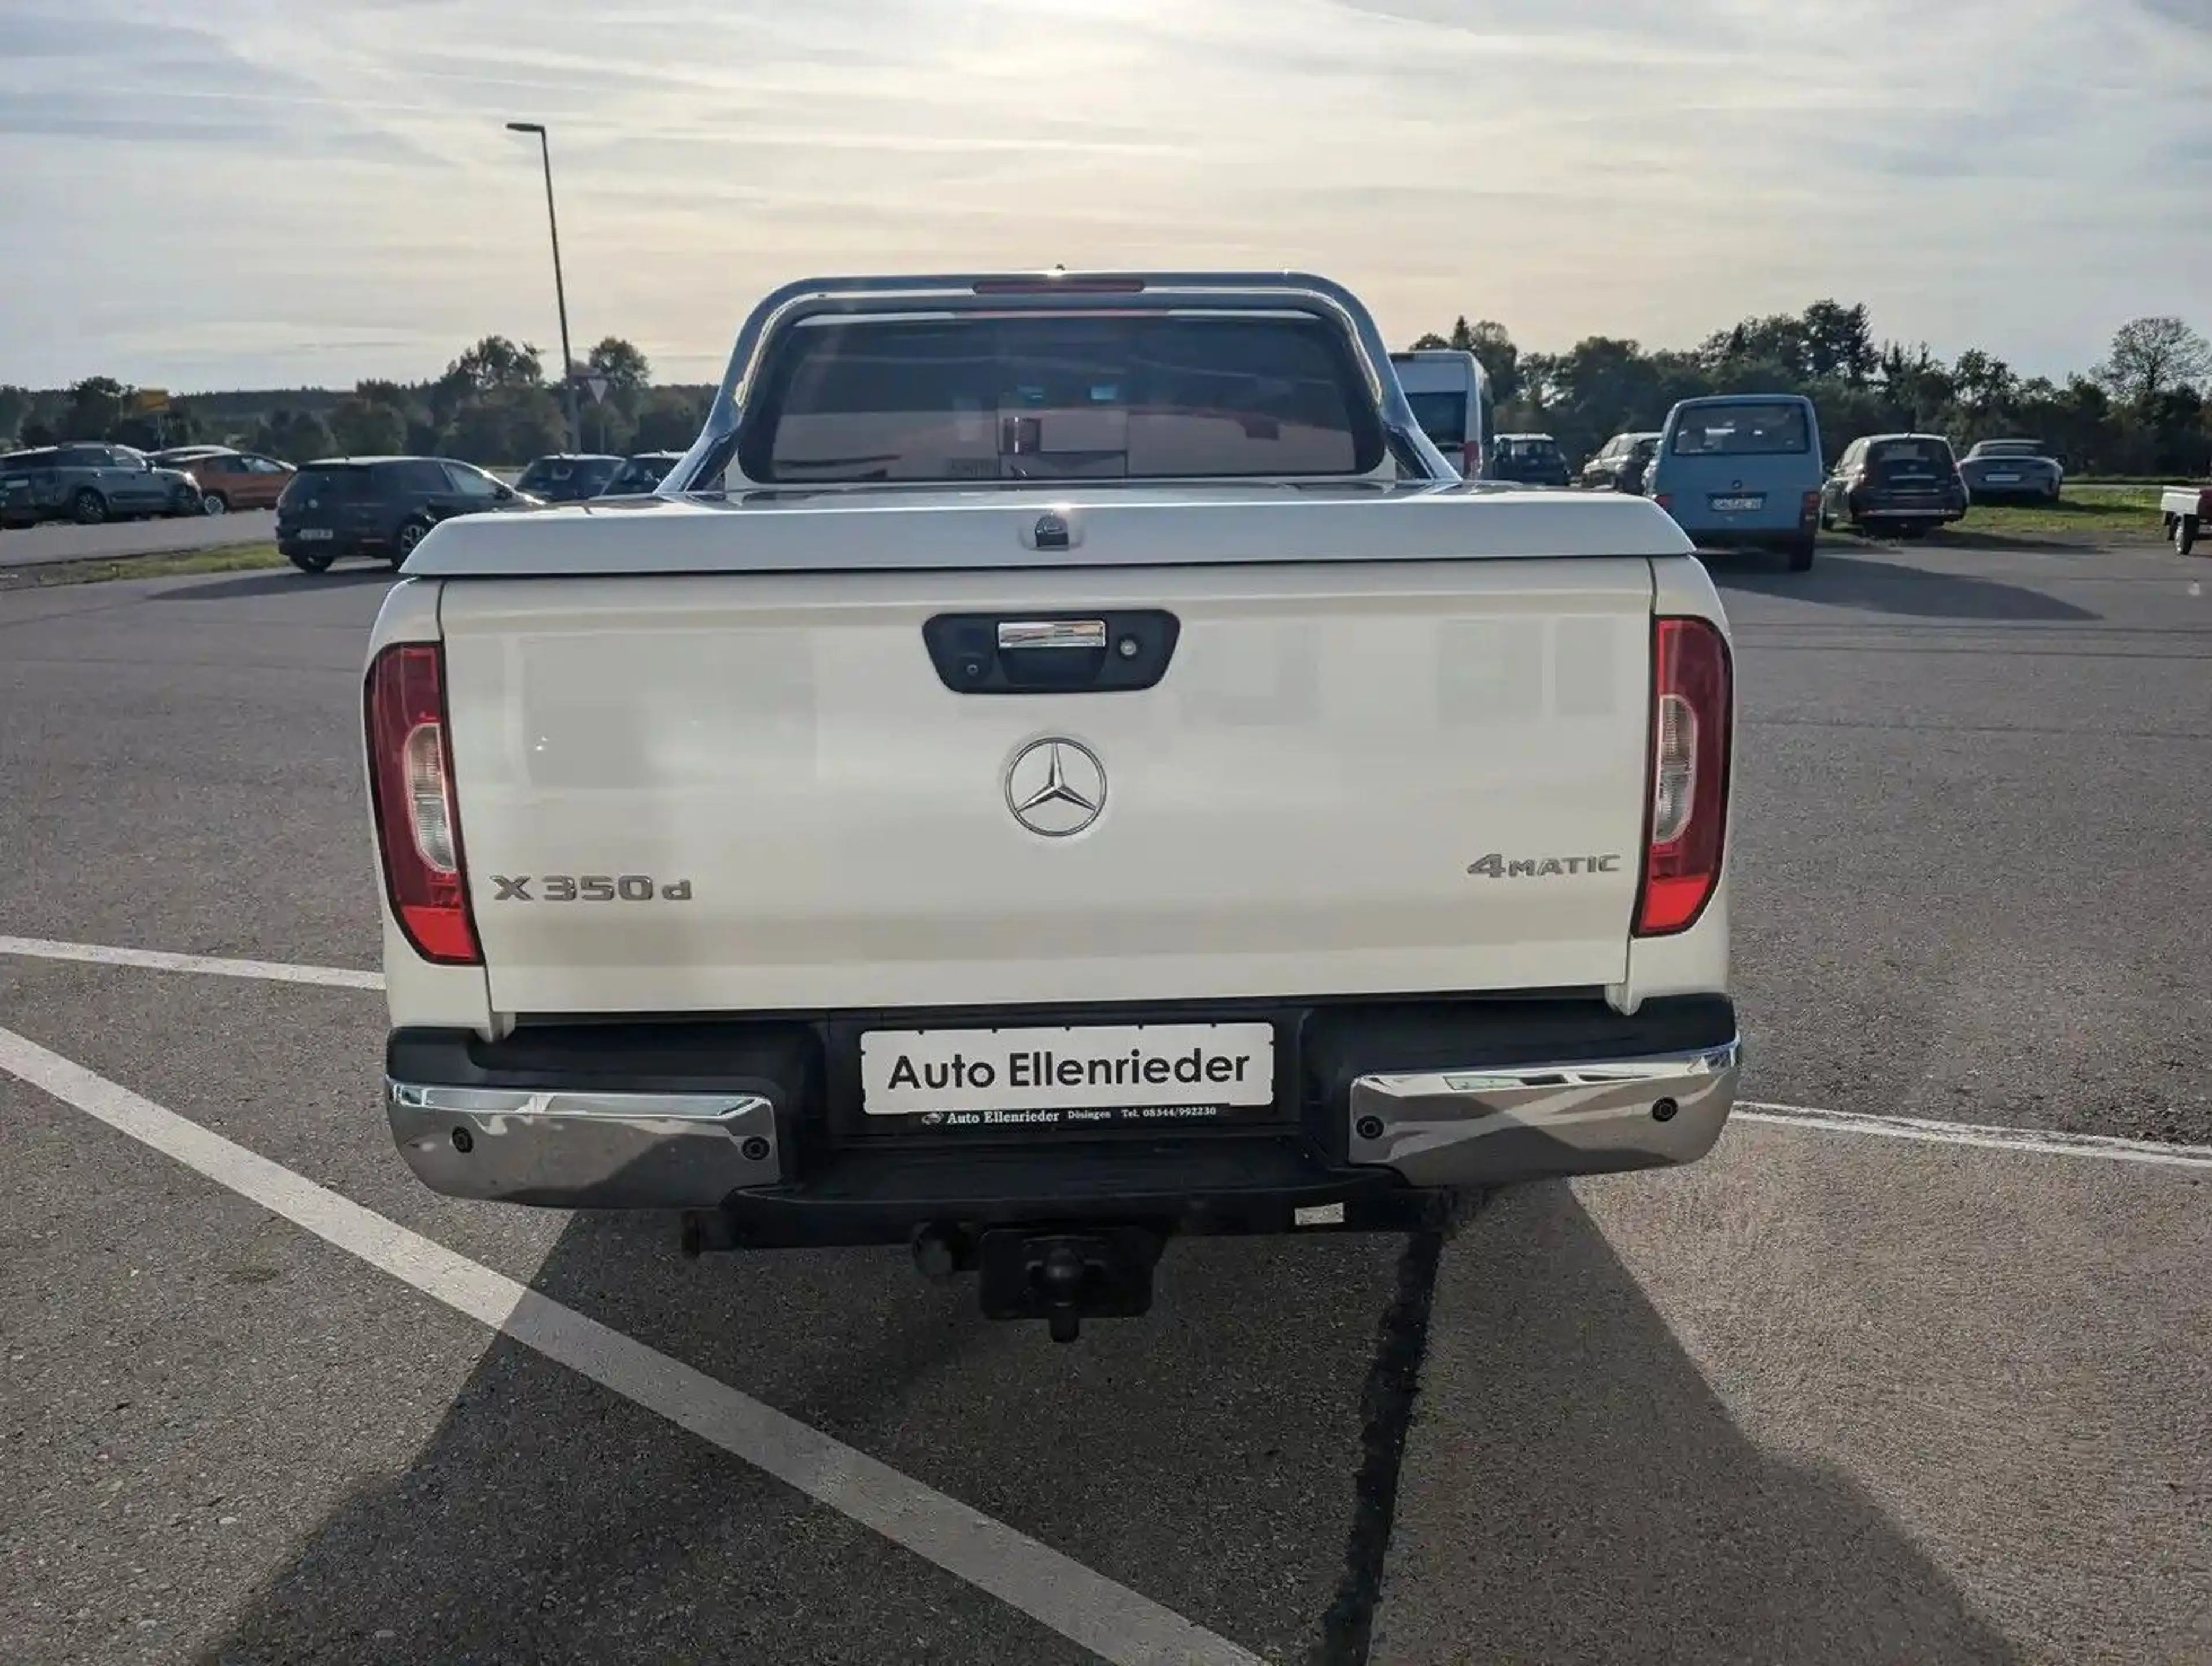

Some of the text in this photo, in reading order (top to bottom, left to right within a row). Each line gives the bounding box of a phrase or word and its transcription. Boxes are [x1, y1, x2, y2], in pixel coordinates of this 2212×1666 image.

[1467, 853, 1621, 878] 4MATIC
[489, 875, 534, 901] X
[888, 1047, 1250, 1089] Auto Ellenrieder
[946, 1112, 980, 1124] Auto
[984, 1109, 1061, 1123] Ellenrieder
